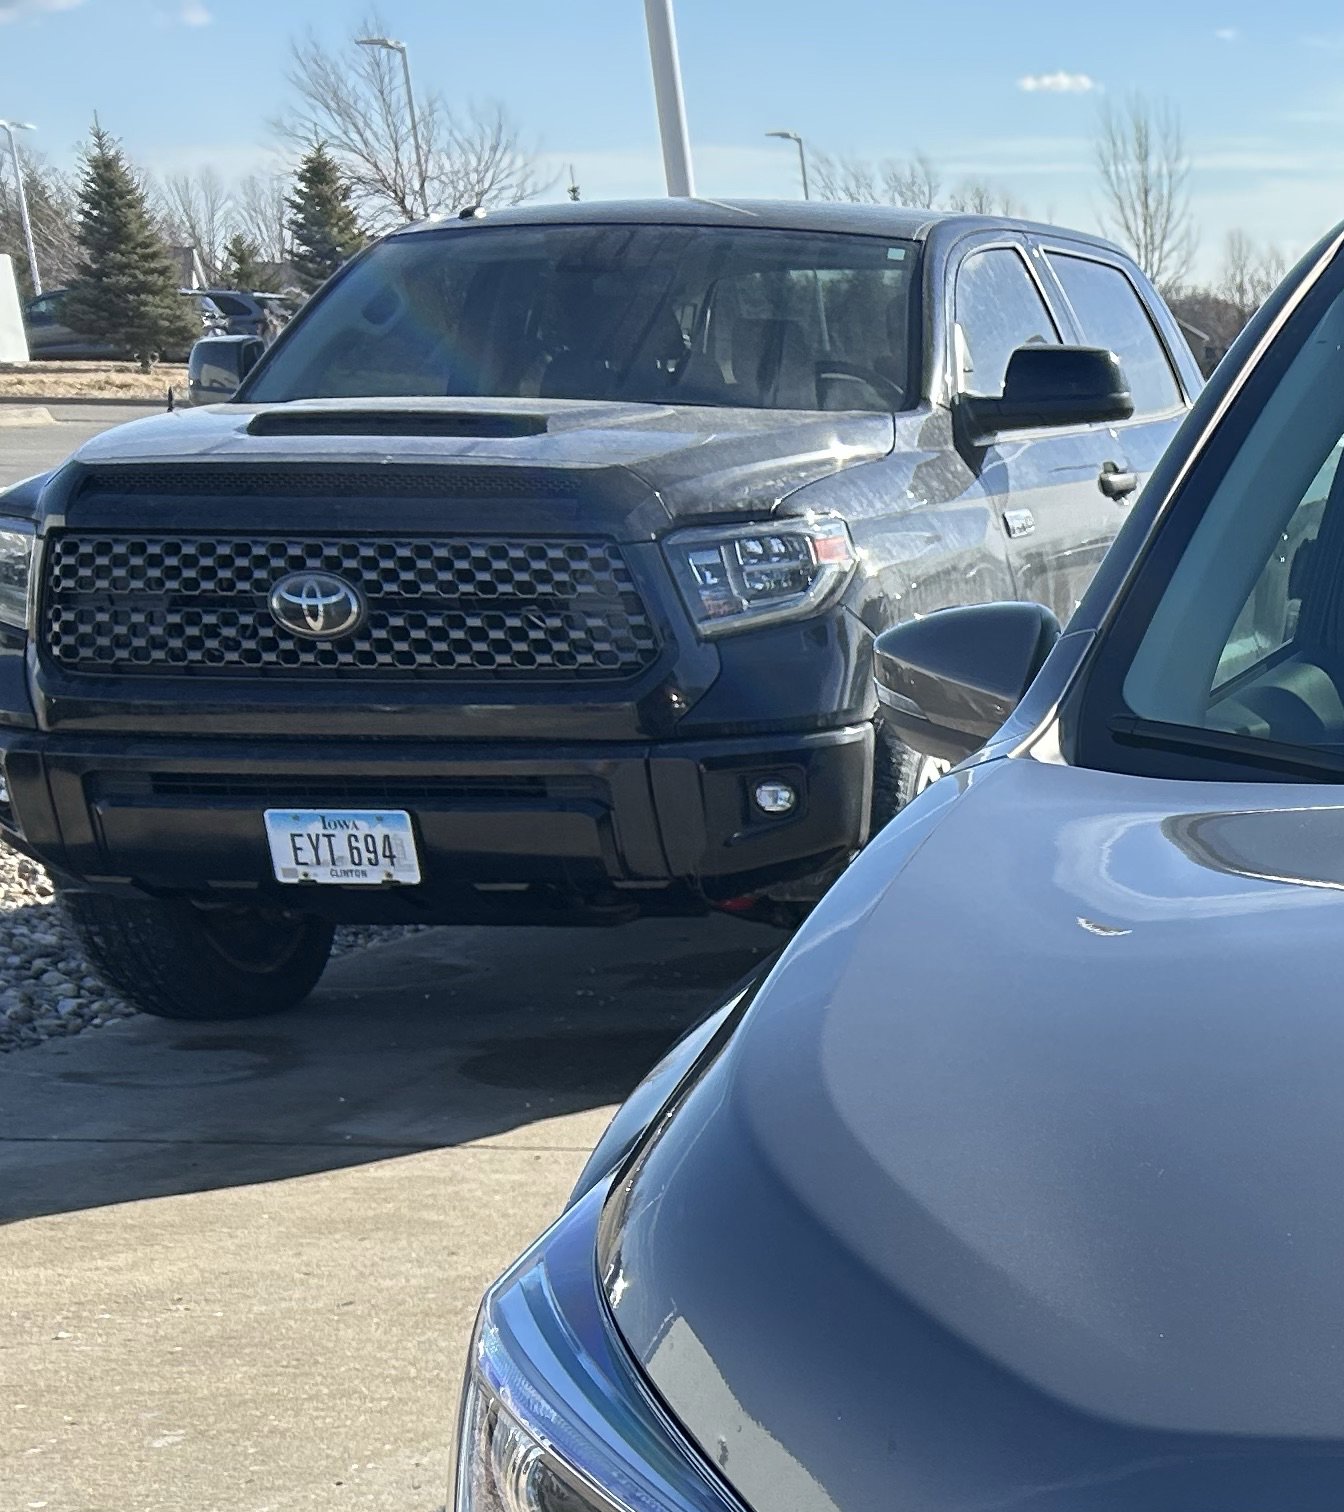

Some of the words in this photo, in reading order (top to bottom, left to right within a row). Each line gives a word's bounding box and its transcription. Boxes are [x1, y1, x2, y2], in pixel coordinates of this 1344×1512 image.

[289, 833, 337, 866] EYT
[347, 833, 397, 868] 694
[329, 868, 368, 878] CLINTON
